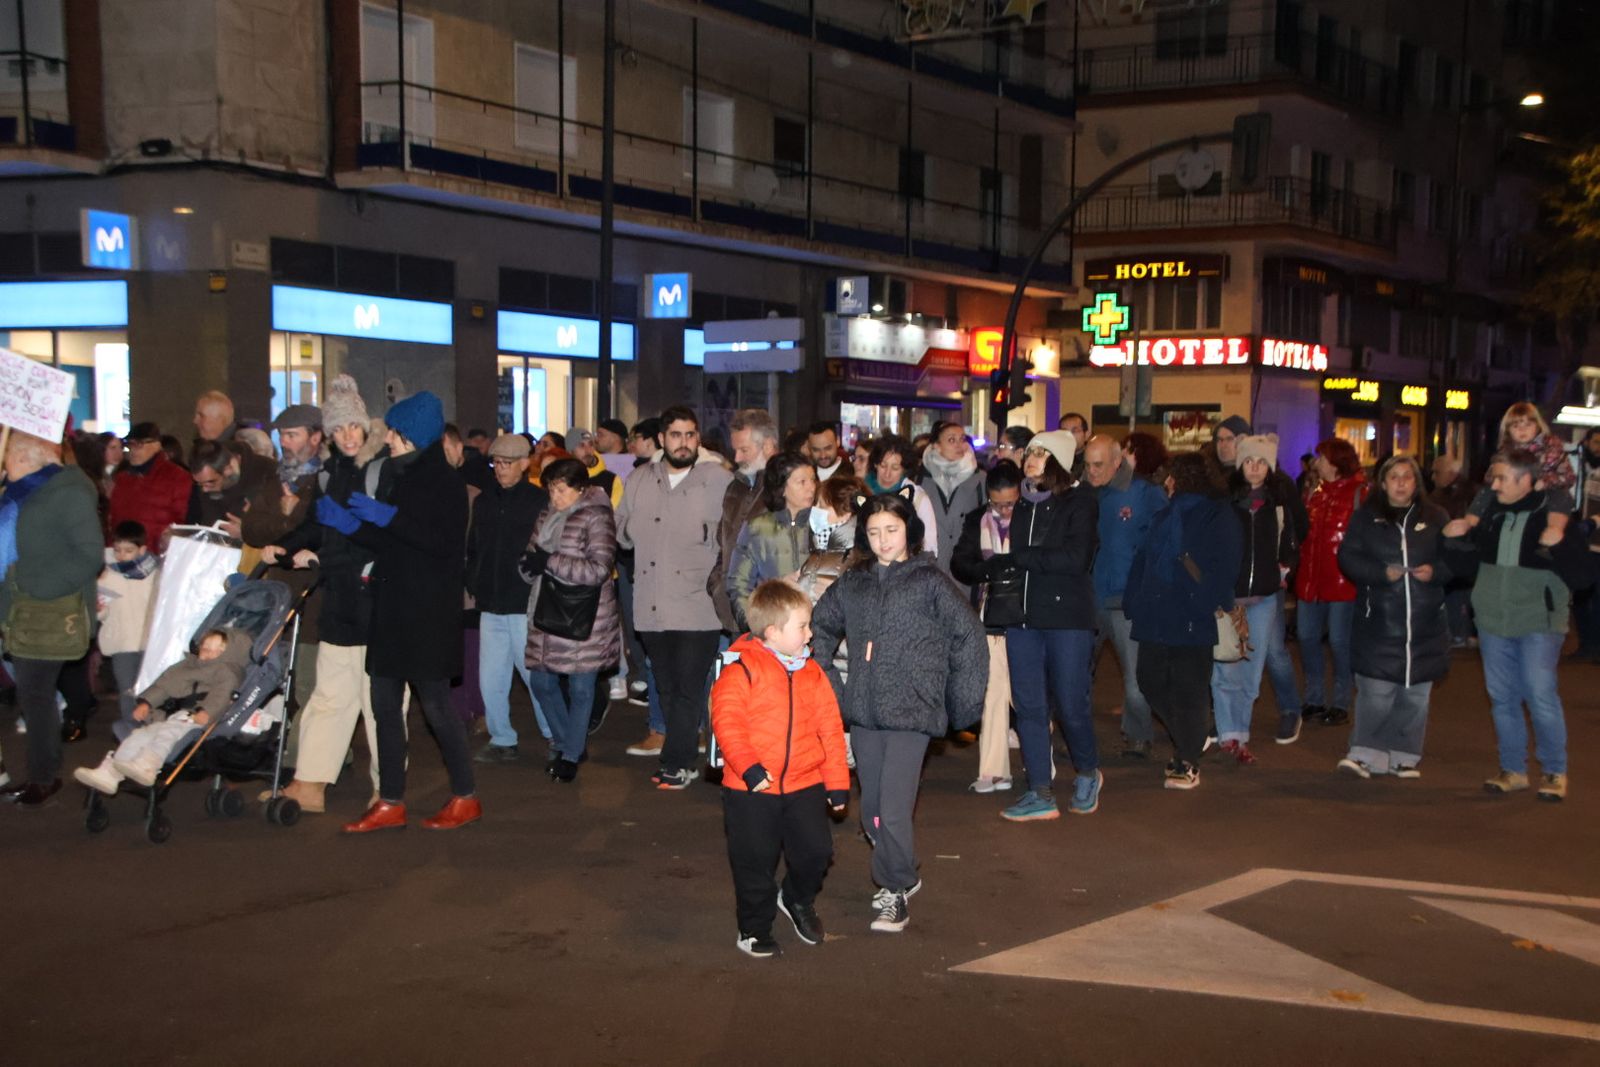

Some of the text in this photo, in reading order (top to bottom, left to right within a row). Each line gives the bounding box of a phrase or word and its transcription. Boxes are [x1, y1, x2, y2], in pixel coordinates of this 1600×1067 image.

[1115, 261, 1191, 280] HOTEL
[1125, 338, 1249, 366] HOTEL
[1261, 338, 1312, 370] HOTEL
